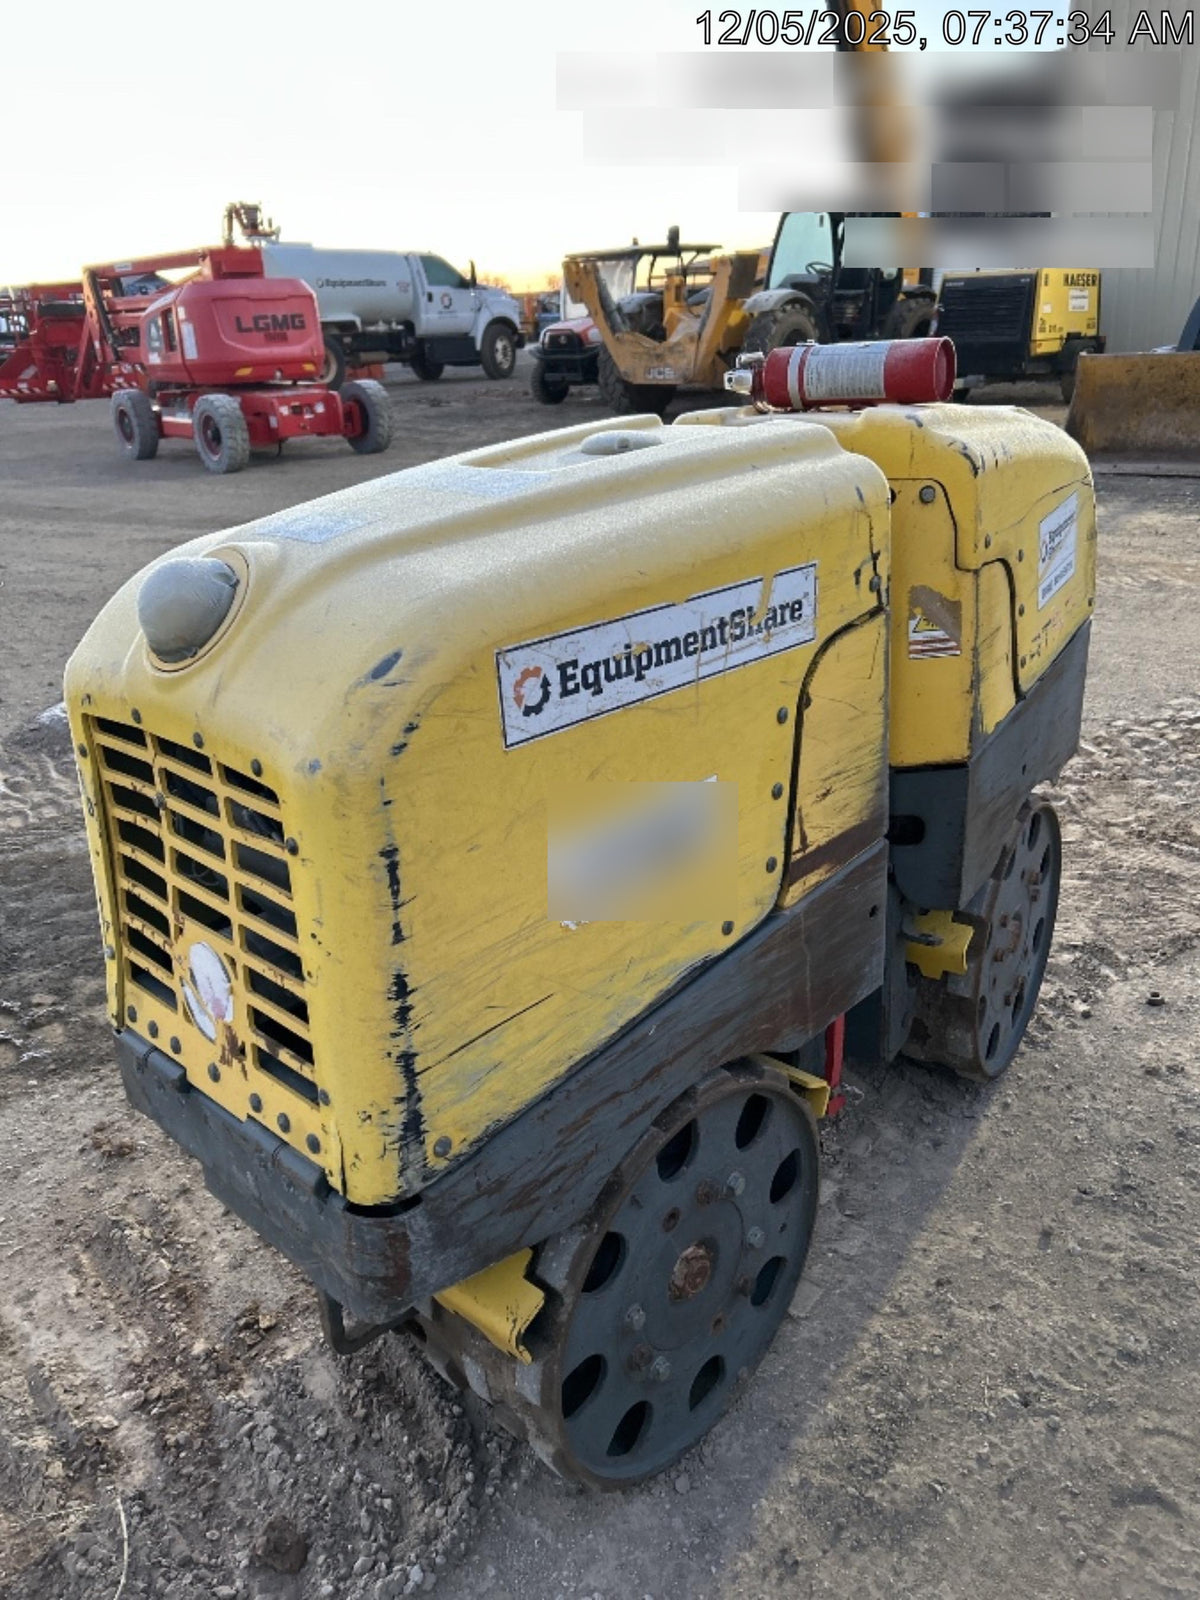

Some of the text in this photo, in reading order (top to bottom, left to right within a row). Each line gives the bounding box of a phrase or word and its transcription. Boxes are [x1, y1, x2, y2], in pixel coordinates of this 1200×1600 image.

[1063, 273, 1098, 287] KAESER
[235, 313, 306, 333] LGMG
[556, 597, 803, 700] EquipmentShare
